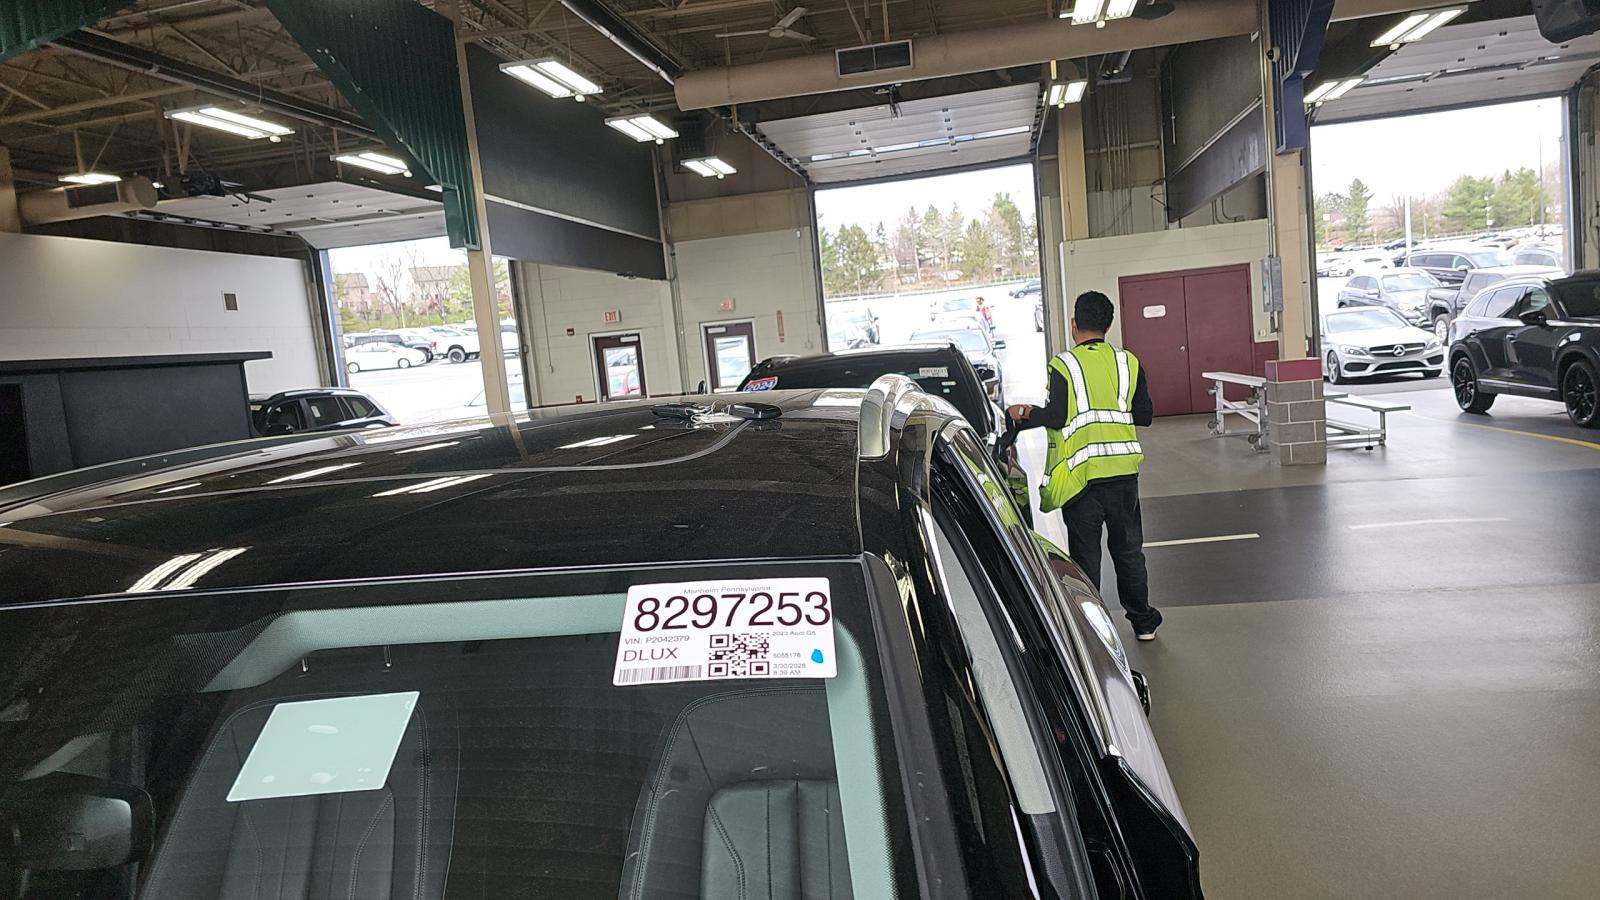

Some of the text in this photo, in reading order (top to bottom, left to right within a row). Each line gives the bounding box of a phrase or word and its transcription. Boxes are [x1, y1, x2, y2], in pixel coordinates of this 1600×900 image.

[634, 591, 831, 632] 8297253
[624, 634, 690, 645] VIN: P2042379
[623, 646, 678, 662] DLUX
